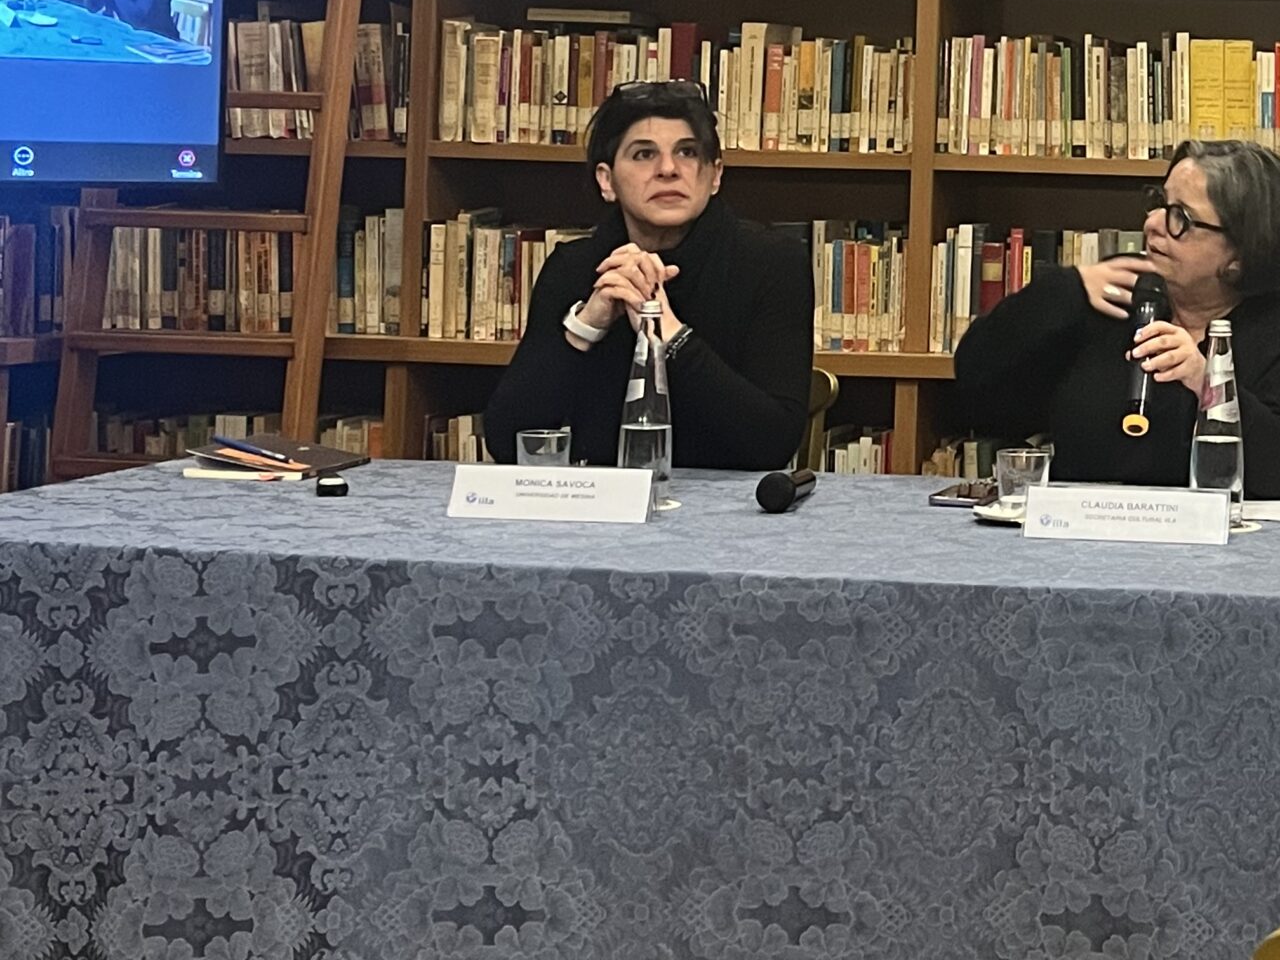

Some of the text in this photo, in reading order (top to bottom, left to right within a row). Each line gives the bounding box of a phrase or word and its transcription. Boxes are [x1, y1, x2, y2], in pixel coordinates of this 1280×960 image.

[556, 479, 596, 489] SAVOCA
[1081, 500, 1179, 513] CLAUDIA BARATTINI
